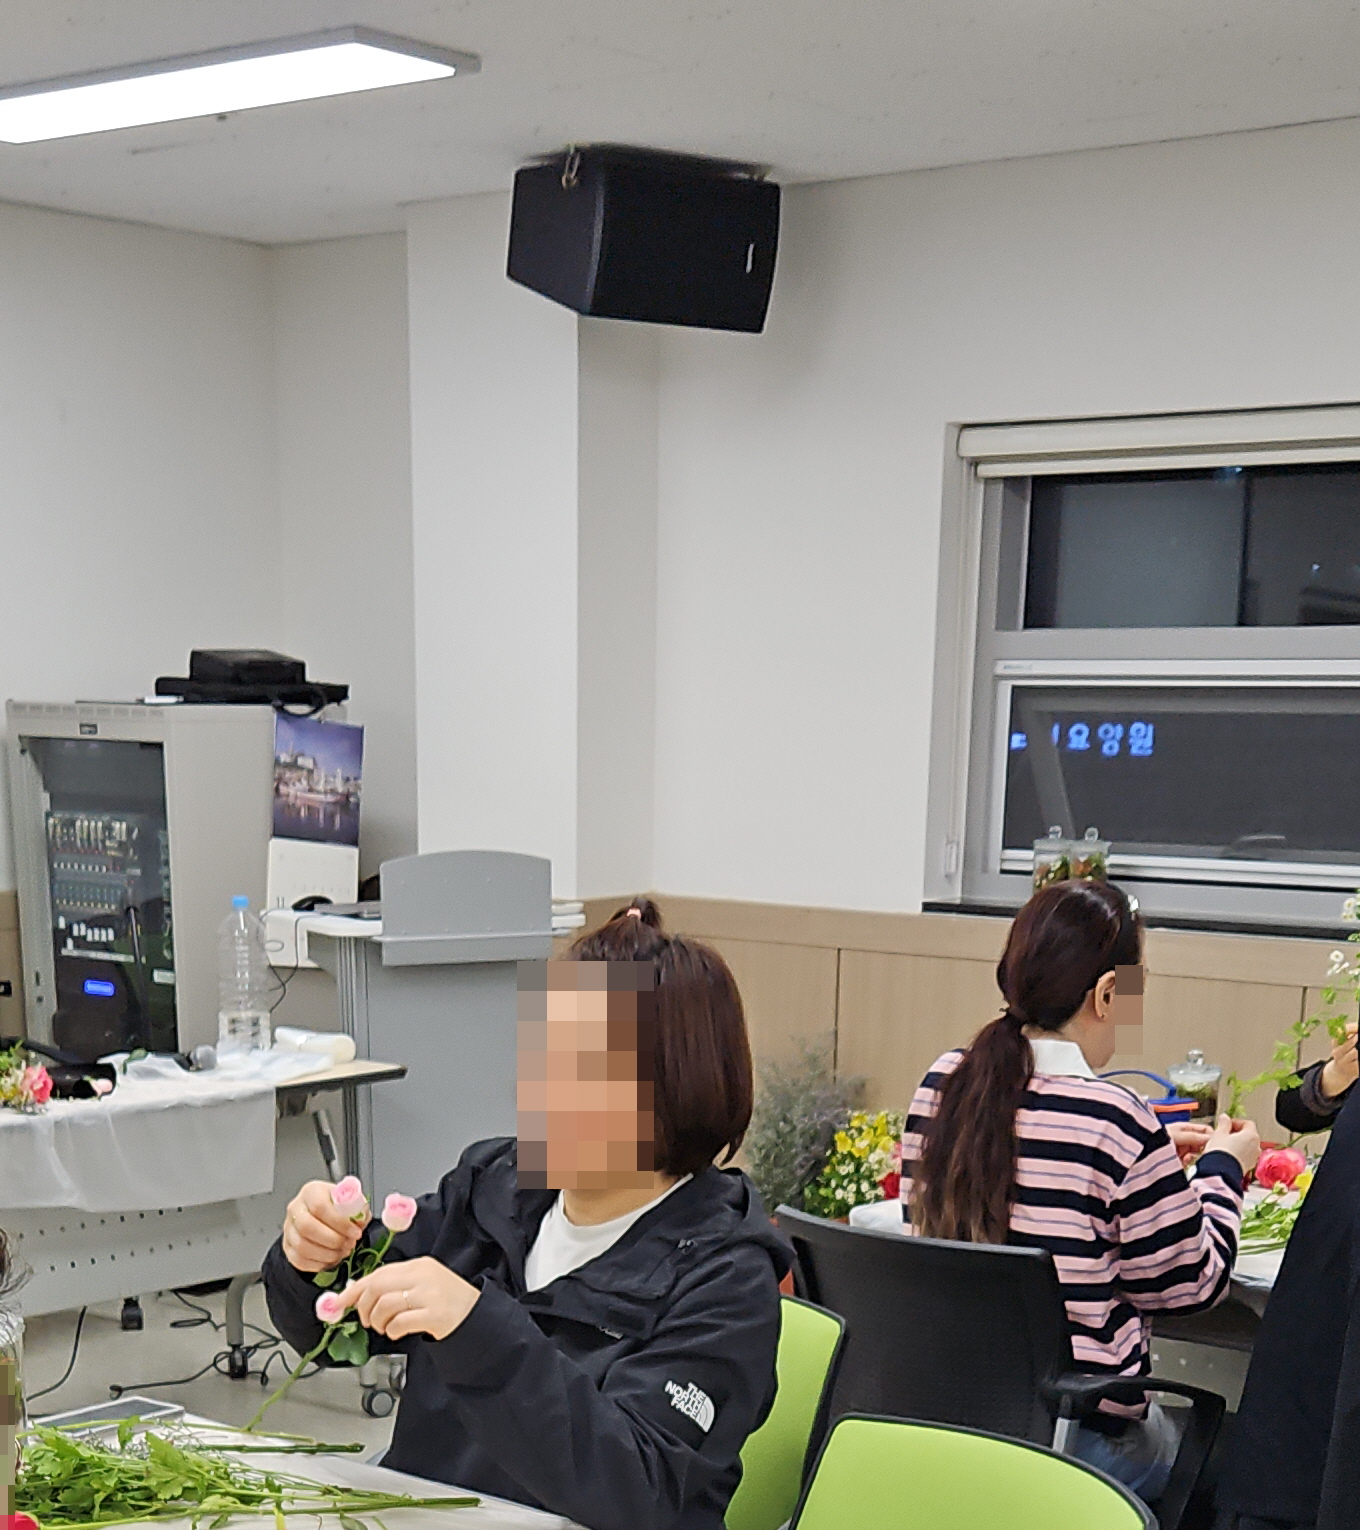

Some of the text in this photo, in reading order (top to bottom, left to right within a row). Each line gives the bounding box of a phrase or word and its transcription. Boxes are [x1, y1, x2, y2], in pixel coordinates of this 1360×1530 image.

[665, 1380, 703, 1411] NORTH
[688, 1382, 707, 1402] THE
[671, 1396, 698, 1419] FACE
